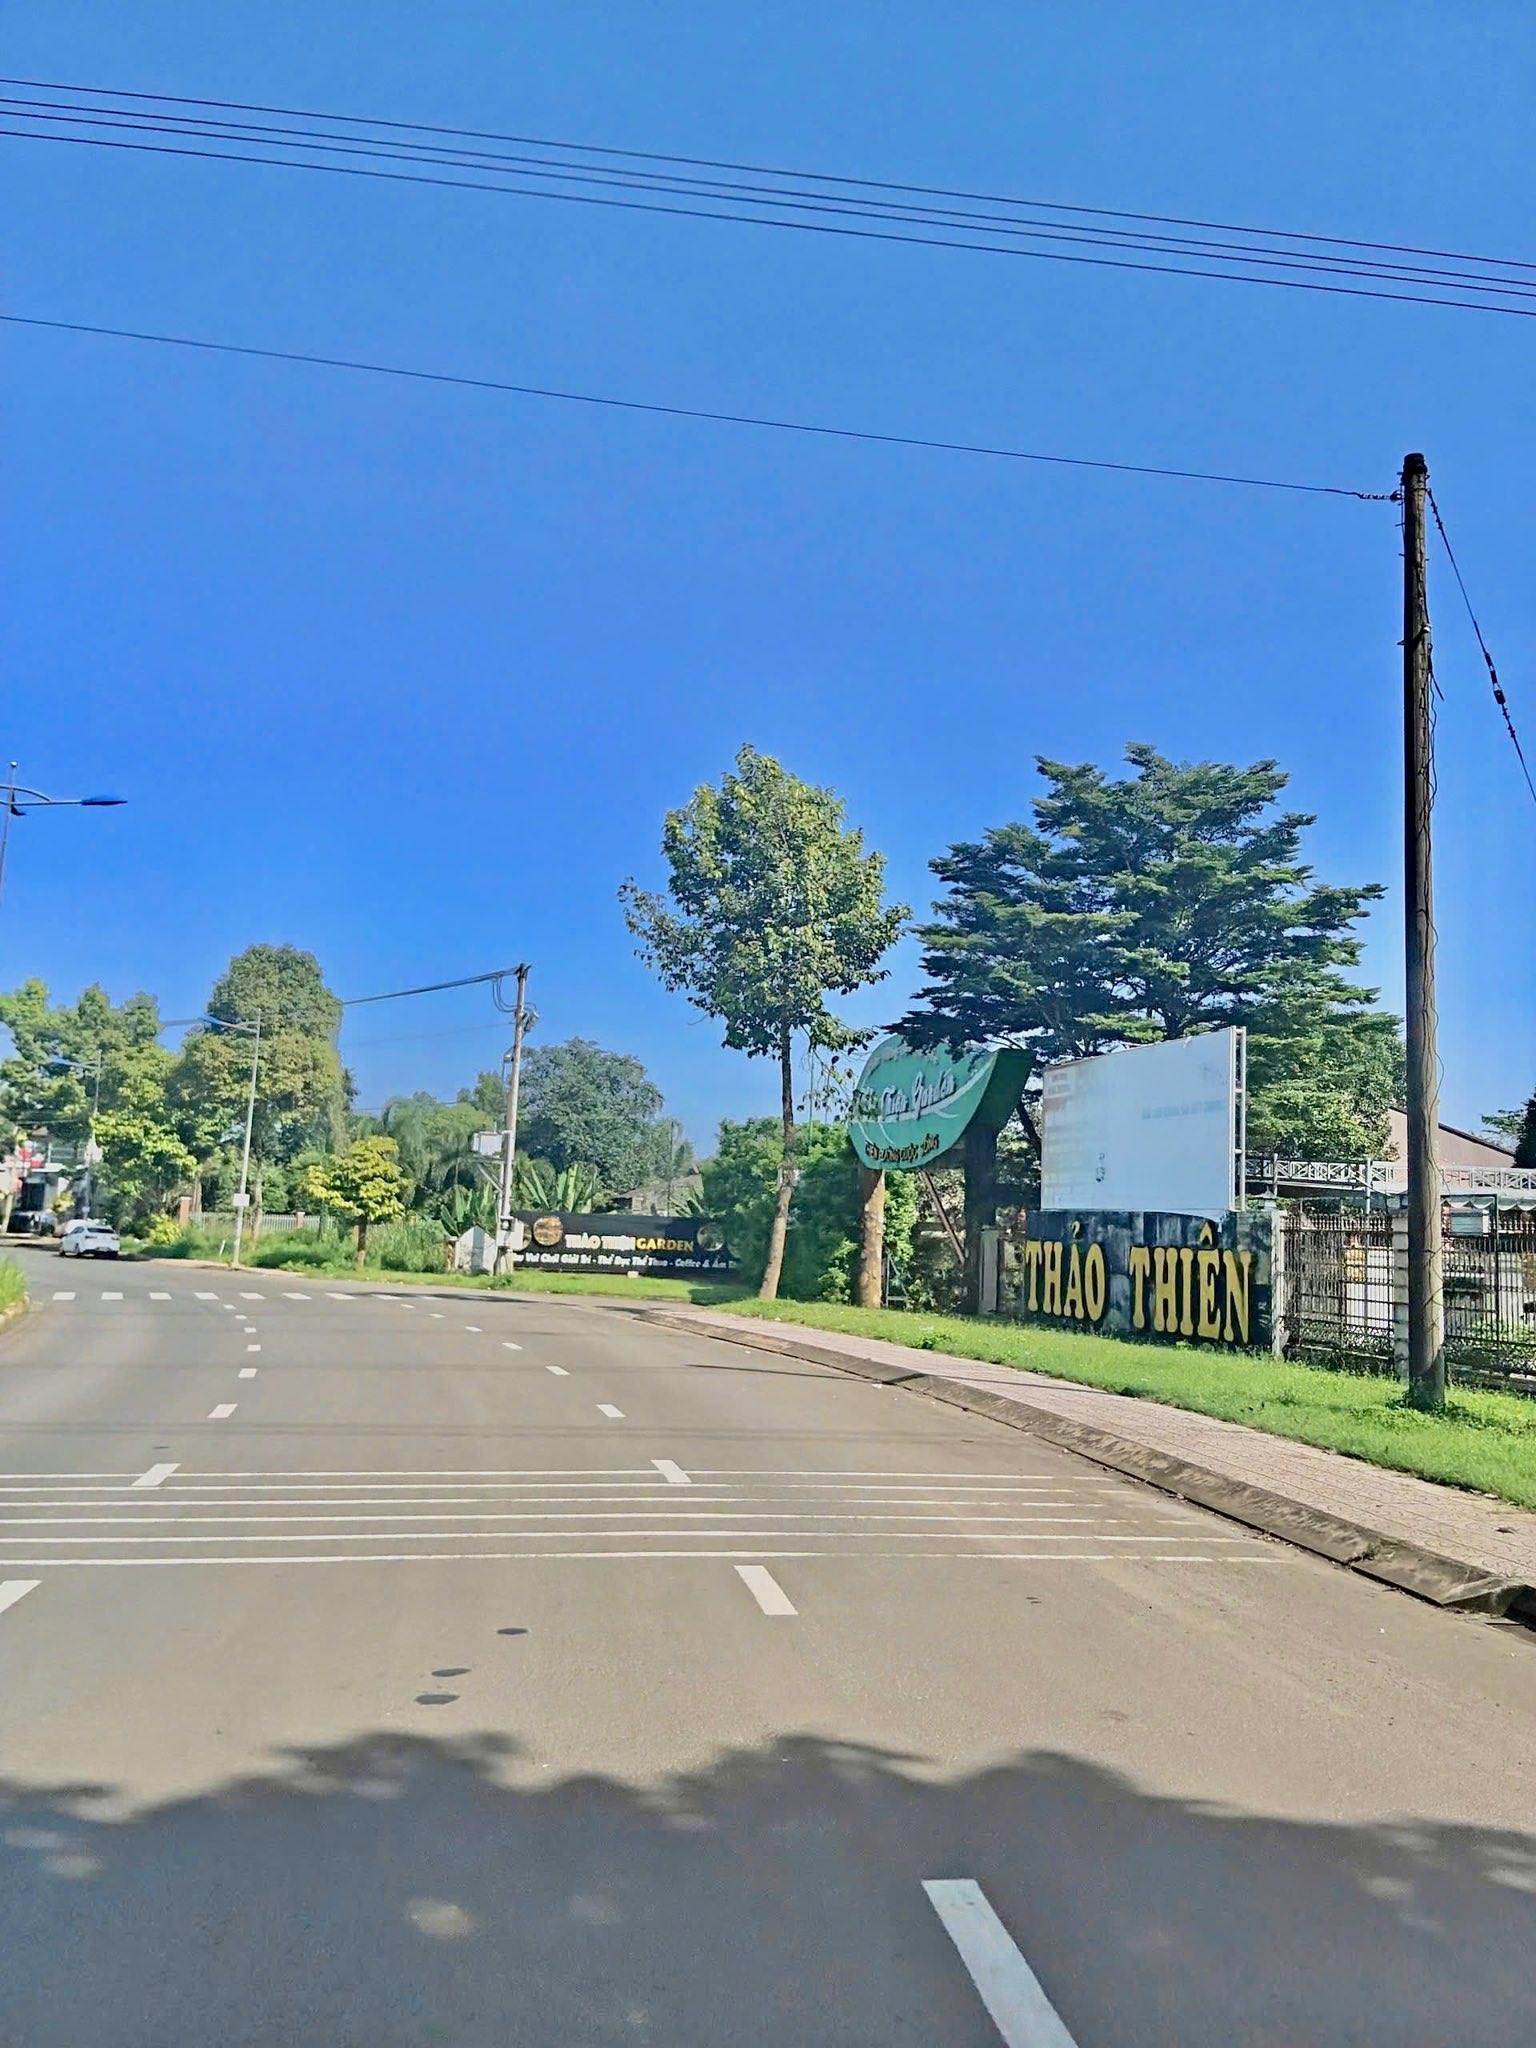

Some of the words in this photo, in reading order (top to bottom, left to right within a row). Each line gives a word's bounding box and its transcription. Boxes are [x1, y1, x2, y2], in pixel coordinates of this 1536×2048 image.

[636, 1237, 695, 1252] GARDEN
[674, 1258, 701, 1268] Coffee
[702, 1259, 711, 1268] &
[1024, 1220, 1106, 1322] THẢO
